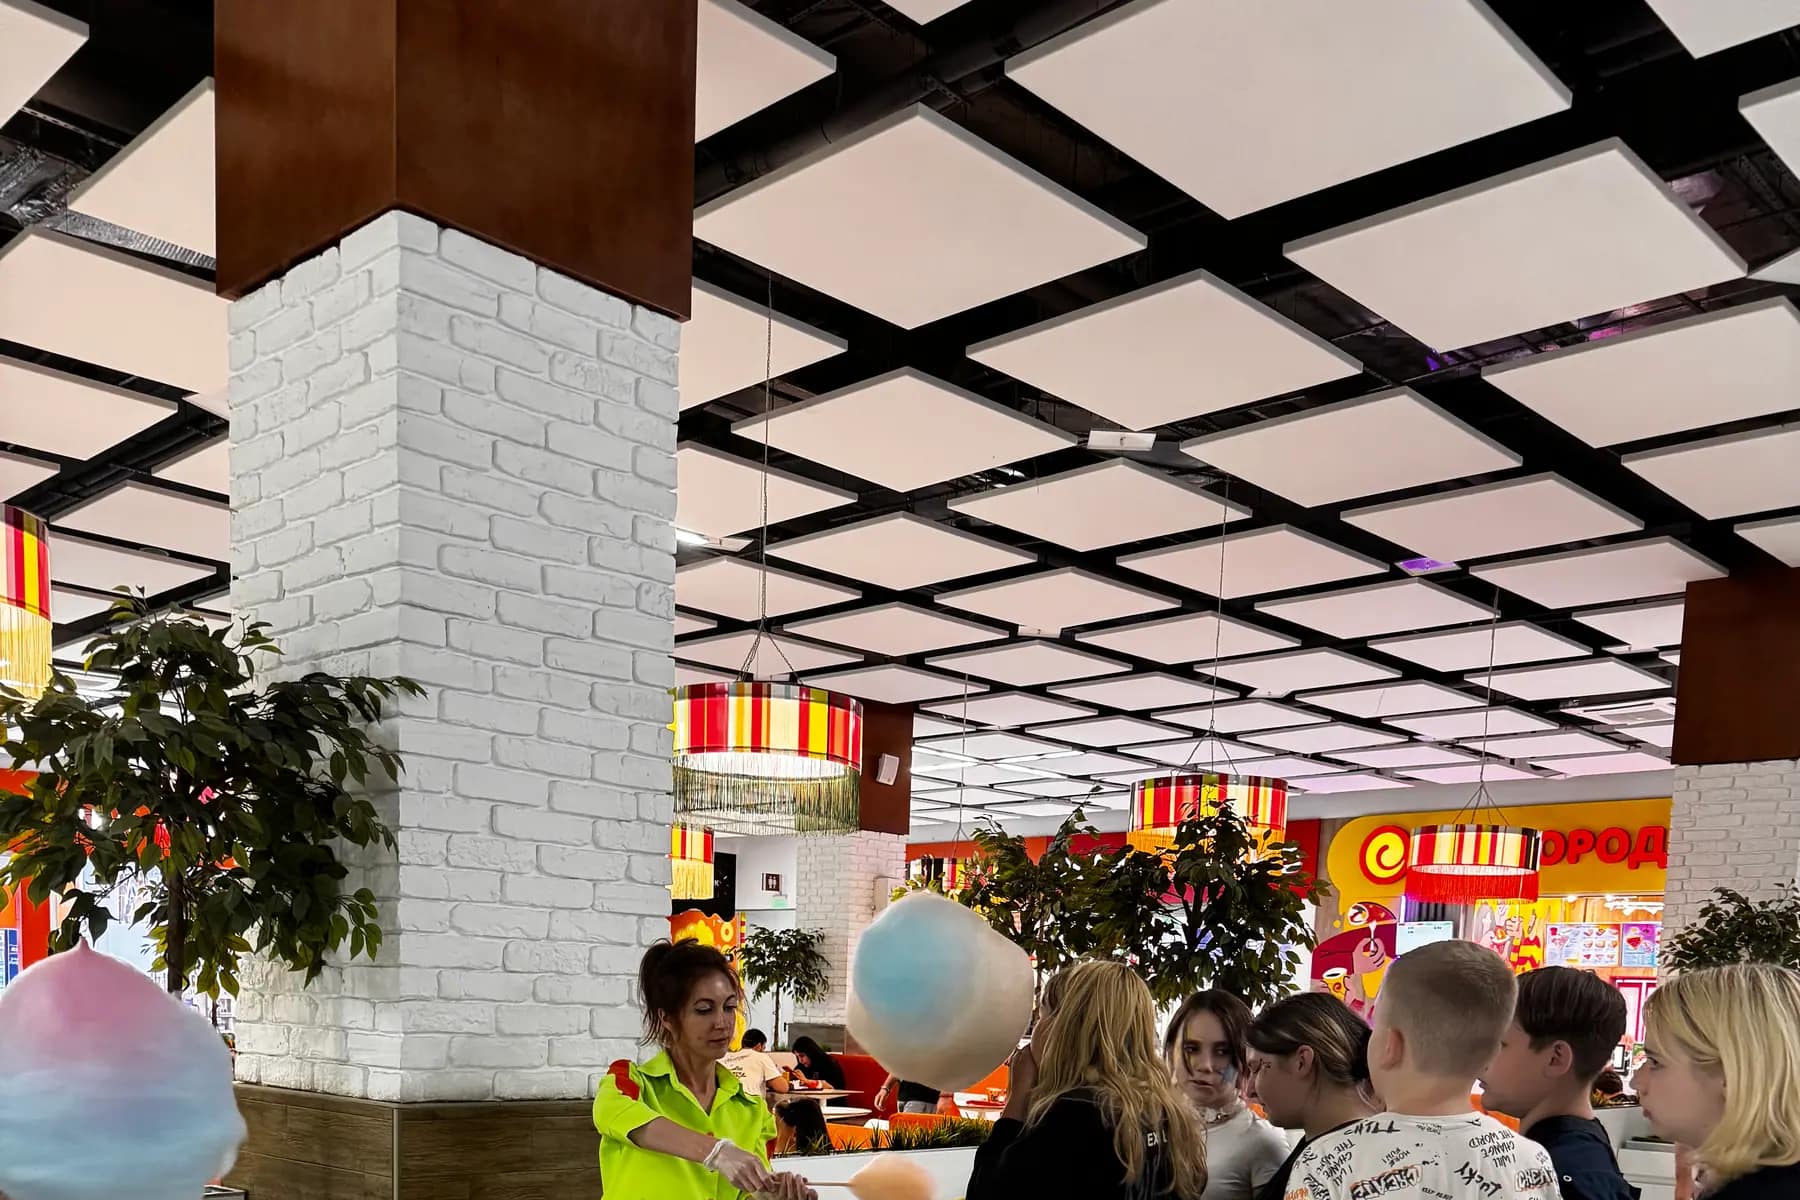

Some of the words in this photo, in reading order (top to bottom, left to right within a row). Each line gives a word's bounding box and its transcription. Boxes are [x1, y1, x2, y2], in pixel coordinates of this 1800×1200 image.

[1344, 1120, 1400, 1135] CHILL
[1499, 1129, 1515, 1141] THE
[1469, 1132, 1499, 1149] WORLD
[1481, 1142, 1515, 1159] CHANGE
[1454, 1161, 1502, 1198] LUCKY
